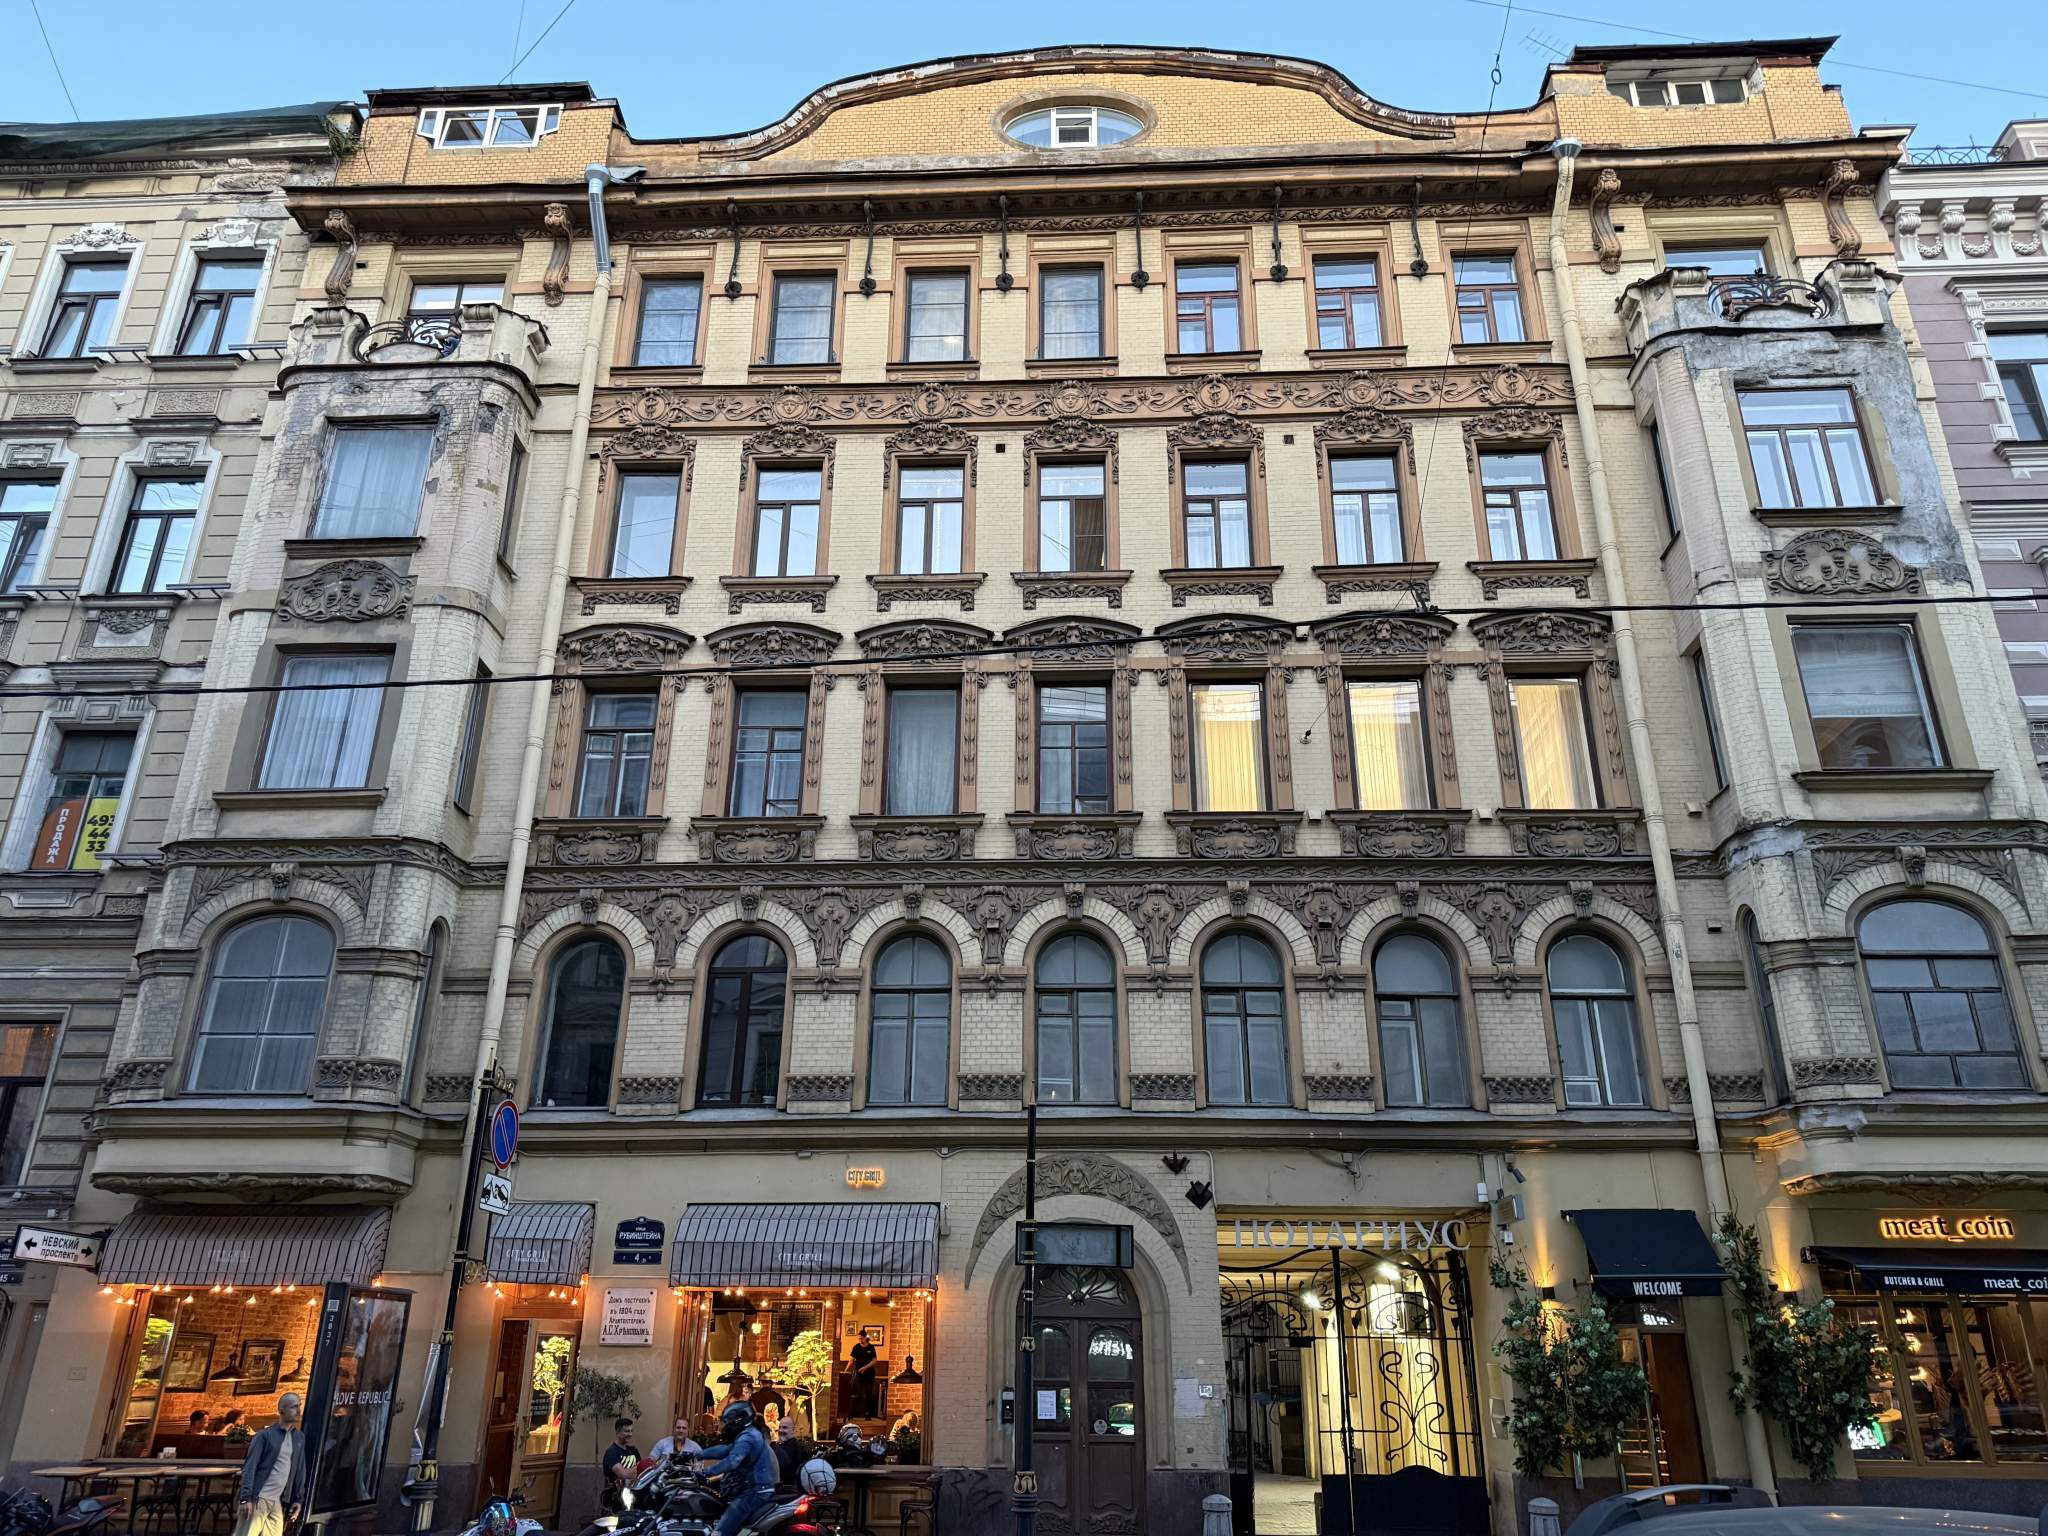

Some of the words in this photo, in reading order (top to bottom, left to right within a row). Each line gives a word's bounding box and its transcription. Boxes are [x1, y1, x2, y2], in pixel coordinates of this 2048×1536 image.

[46, 808, 70, 864] ПРОДАЖА
[87, 828, 110, 839] 44
[85, 840, 106, 852] 33
[619, 1230, 661, 1240] РУБИНШТЕЙНА
[1234, 1217, 1471, 1251] НОТАРИУС
[1882, 1215, 2016, 1241] meat_coin
[42, 1236, 80, 1250] НЕВСКИЙ
[40, 1248, 76, 1260] проспект
[506, 1249, 525, 1259] CITY
[526, 1249, 550, 1259] GRILL
[1632, 1281, 1683, 1295] WELCOME
[1884, 1275, 1917, 1286] BUTCHER
[1917, 1276, 1924, 1286] &
[1924, 1277, 1945, 1287] GRILL
[1983, 1276, 2048, 1292] meat_coi
[335, 1391, 357, 1406] LOVE
[358, 1390, 392, 1404] REPUBLIC
